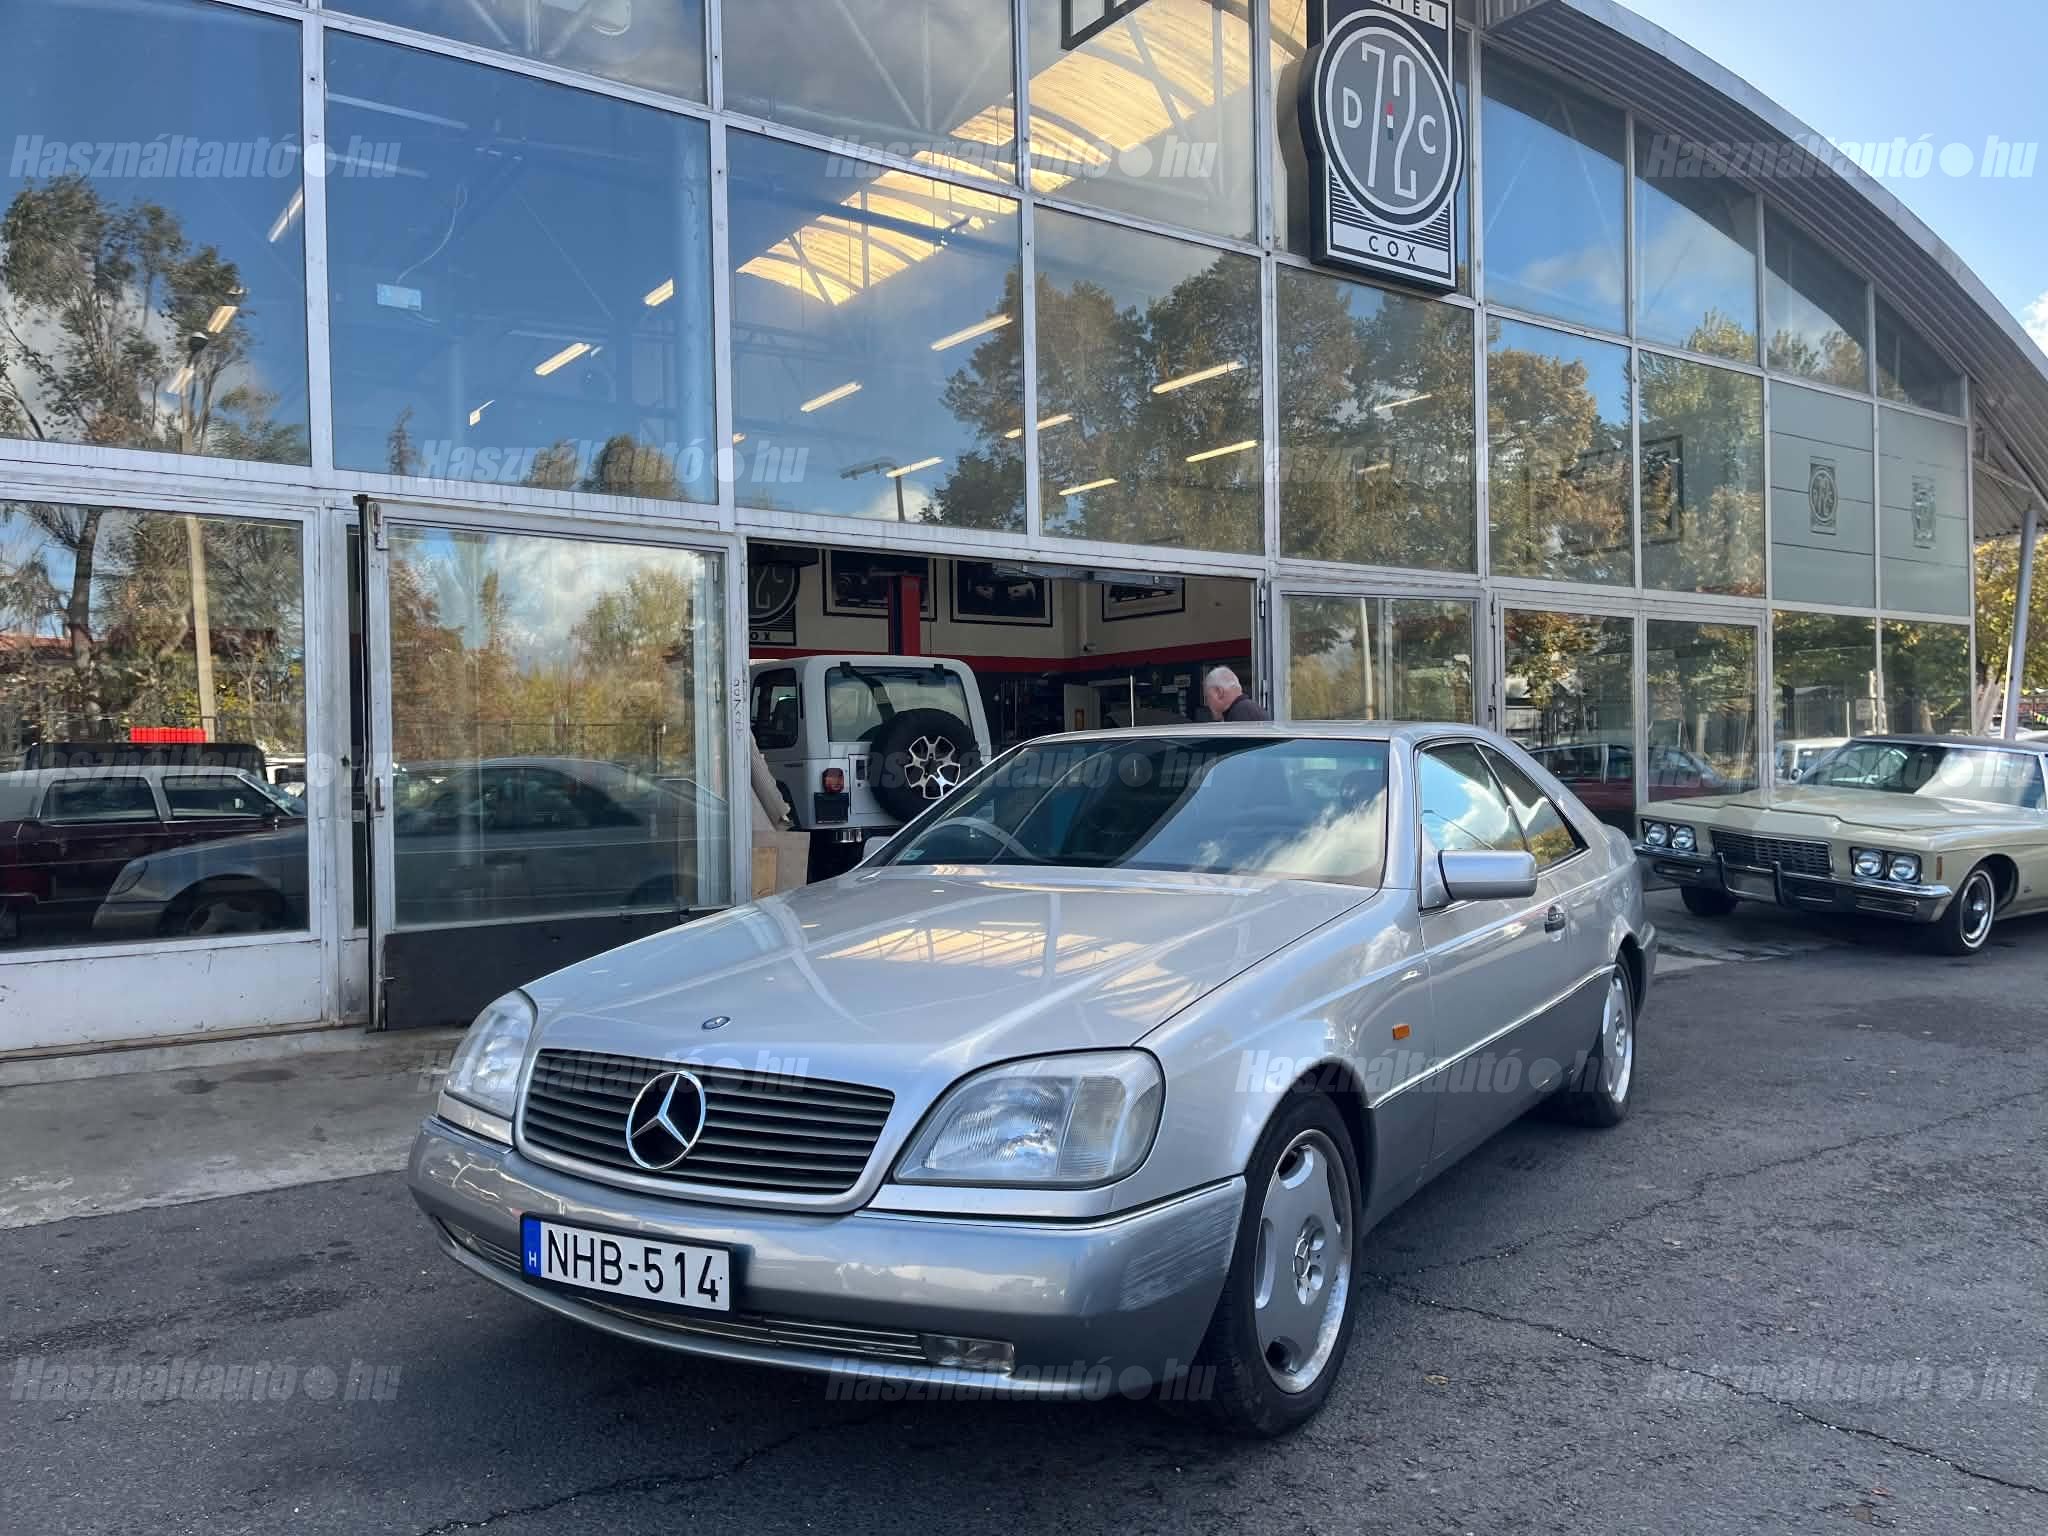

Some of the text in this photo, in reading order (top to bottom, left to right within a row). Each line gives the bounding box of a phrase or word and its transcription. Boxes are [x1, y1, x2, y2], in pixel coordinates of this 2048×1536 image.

[1378, 0, 1435, 21] IEL
[1361, 41, 1417, 200] 72
[1368, 235, 1417, 263] COX
[749, 631, 771, 641] OX
[528, 1229, 719, 1303] H NHB-514
